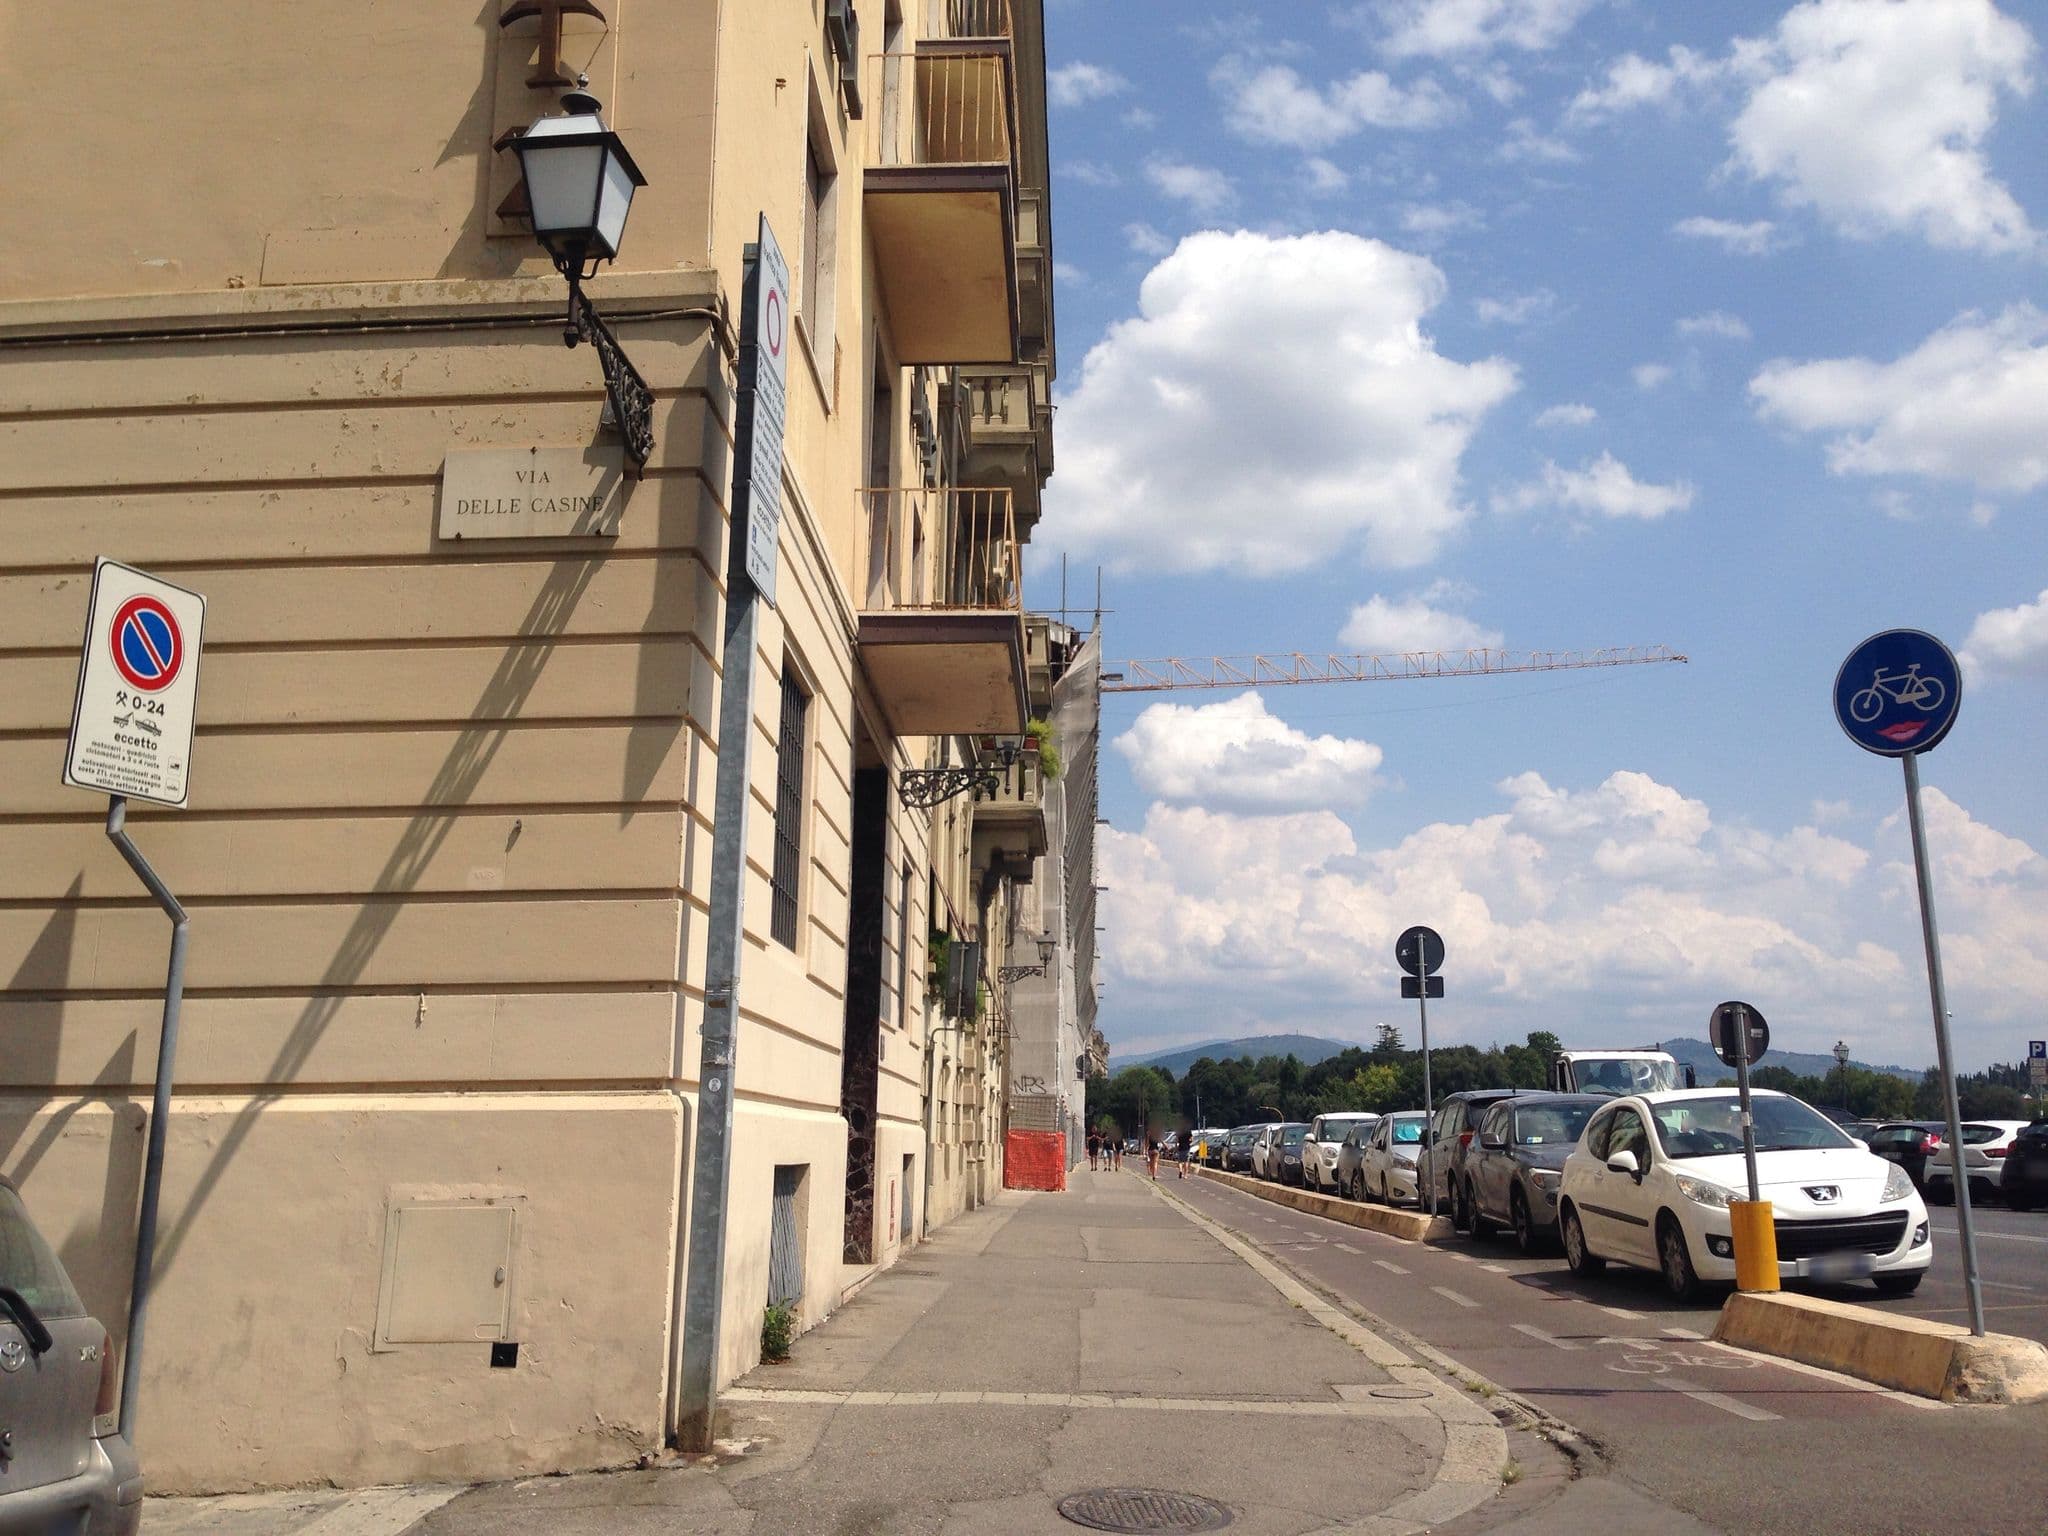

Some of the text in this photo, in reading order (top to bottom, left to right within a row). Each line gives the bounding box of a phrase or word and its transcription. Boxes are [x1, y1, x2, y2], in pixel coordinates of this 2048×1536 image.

[515, 470, 551, 484] VIA
[457, 496, 605, 516] DELLE CASINE
[132, 695, 165, 717] 0-24
[114, 732, 158, 751] eccetto
[2031, 1042, 2043, 1057] P
